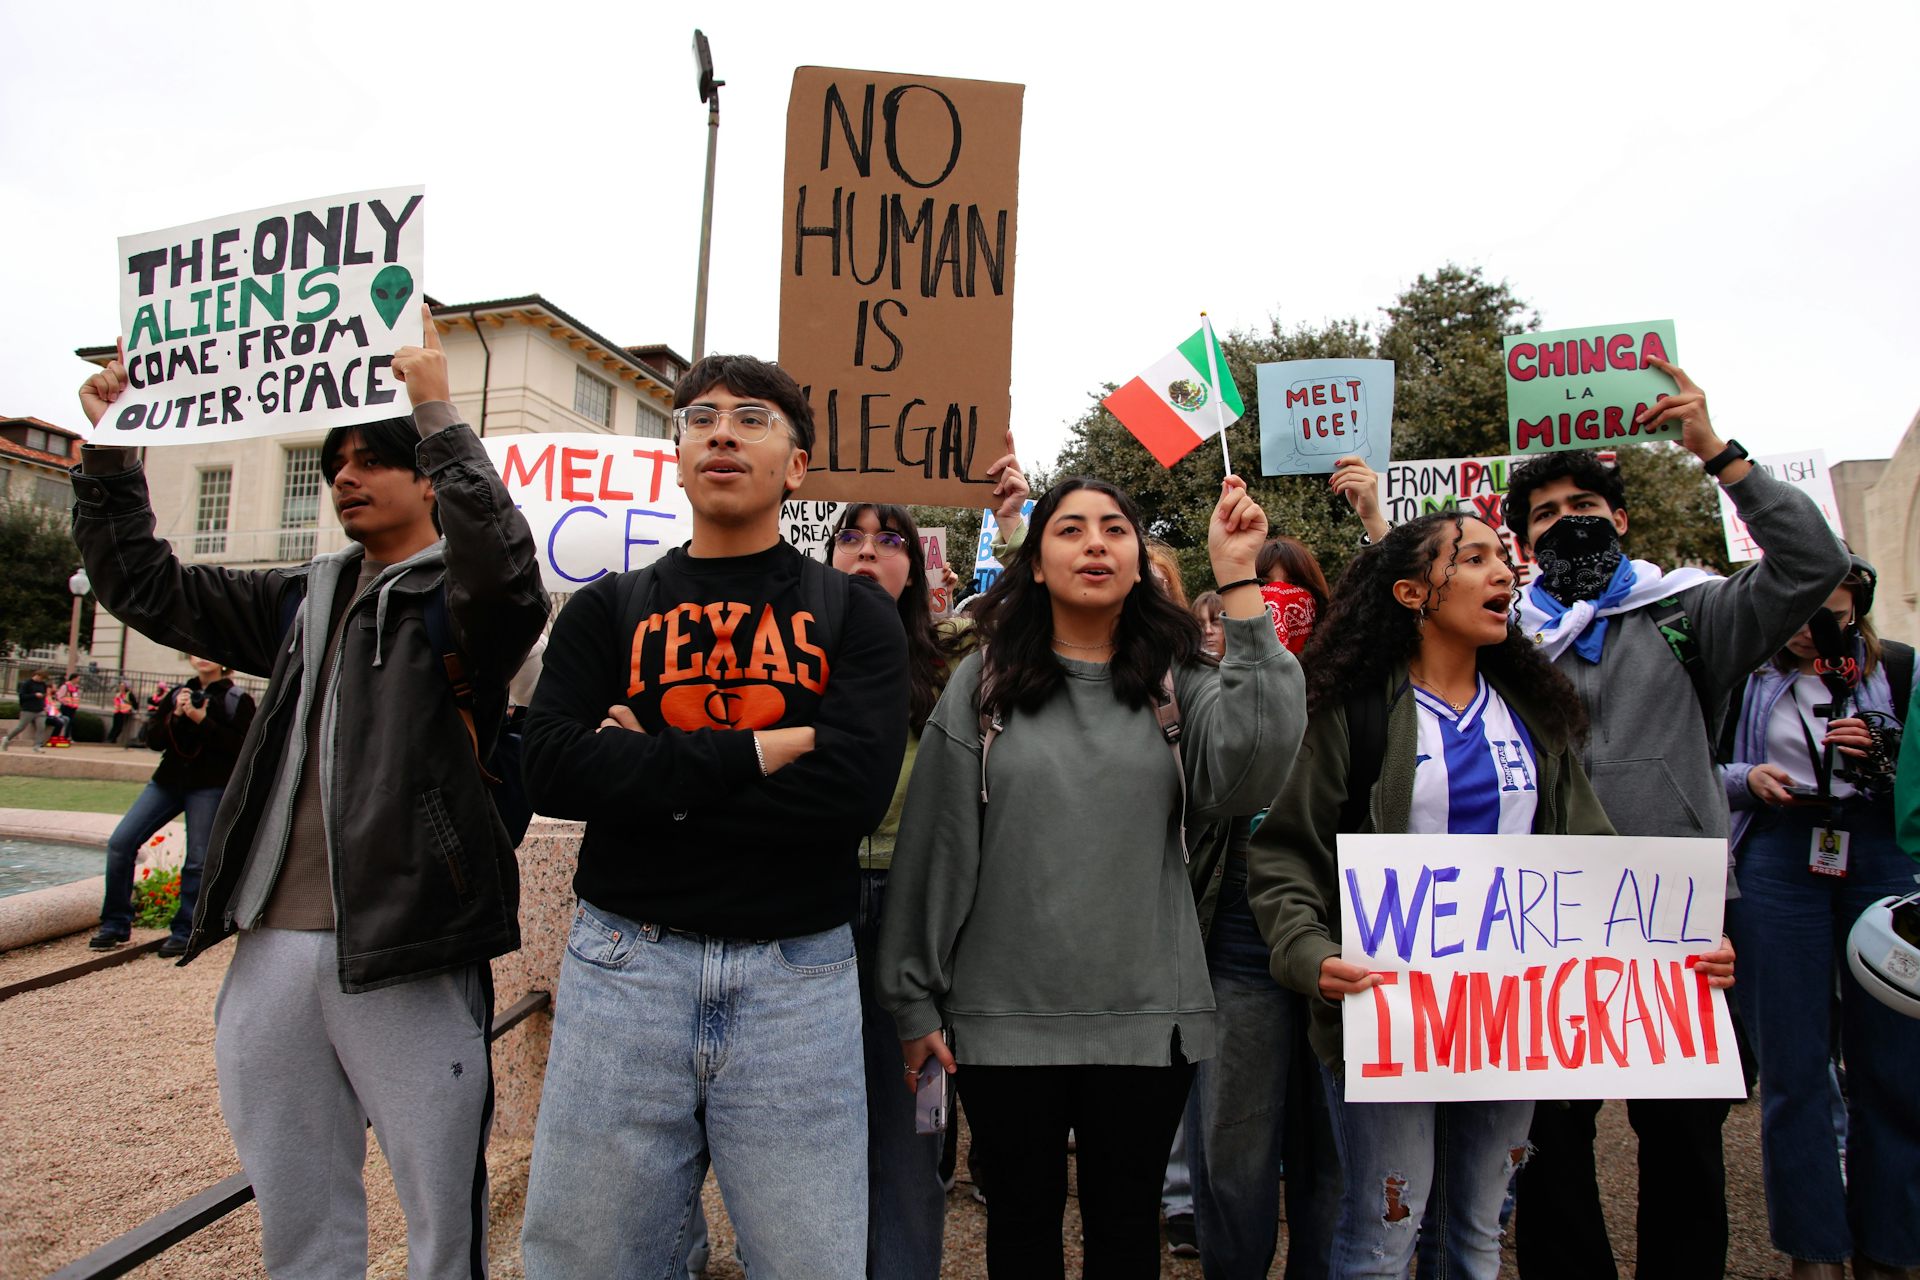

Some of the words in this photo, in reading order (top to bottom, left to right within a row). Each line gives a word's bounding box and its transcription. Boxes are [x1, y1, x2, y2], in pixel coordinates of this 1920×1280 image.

[820, 83, 962, 188] NO
[128, 228, 241, 297] THE
[252, 195, 424, 275] ONLY
[795, 185, 1007, 298] HUMAN
[128, 265, 341, 351] ALIENS
[854, 299, 908, 372] IS
[128, 338, 218, 390] COME
[239, 315, 369, 370] FROM
[1508, 332, 1670, 381] CHINGA
[116, 386, 243, 431] OUTER
[257, 354, 397, 413] SPACE
[1286, 381, 1361, 409] MELT
[1302, 410, 1358, 440] ICE!
[1566, 387, 1594, 400] LA
[797, 384, 998, 484] LEGAL
[502, 444, 679, 503] MELT
[1387, 465, 1457, 497] FROM
[1387, 497, 1418, 522] TO
[781, 502, 809, 521] AVE
[815, 502, 837, 521] UP
[791, 524, 831, 545] DREA
[627, 602, 830, 698] TEXAS
[1812, 866, 1842, 877] PRESS
[1346, 864, 1464, 962] WE
[1477, 866, 1583, 953] ARE
[1605, 868, 1712, 947] ALL
[1362, 954, 1719, 1078] IMMIGRANT
